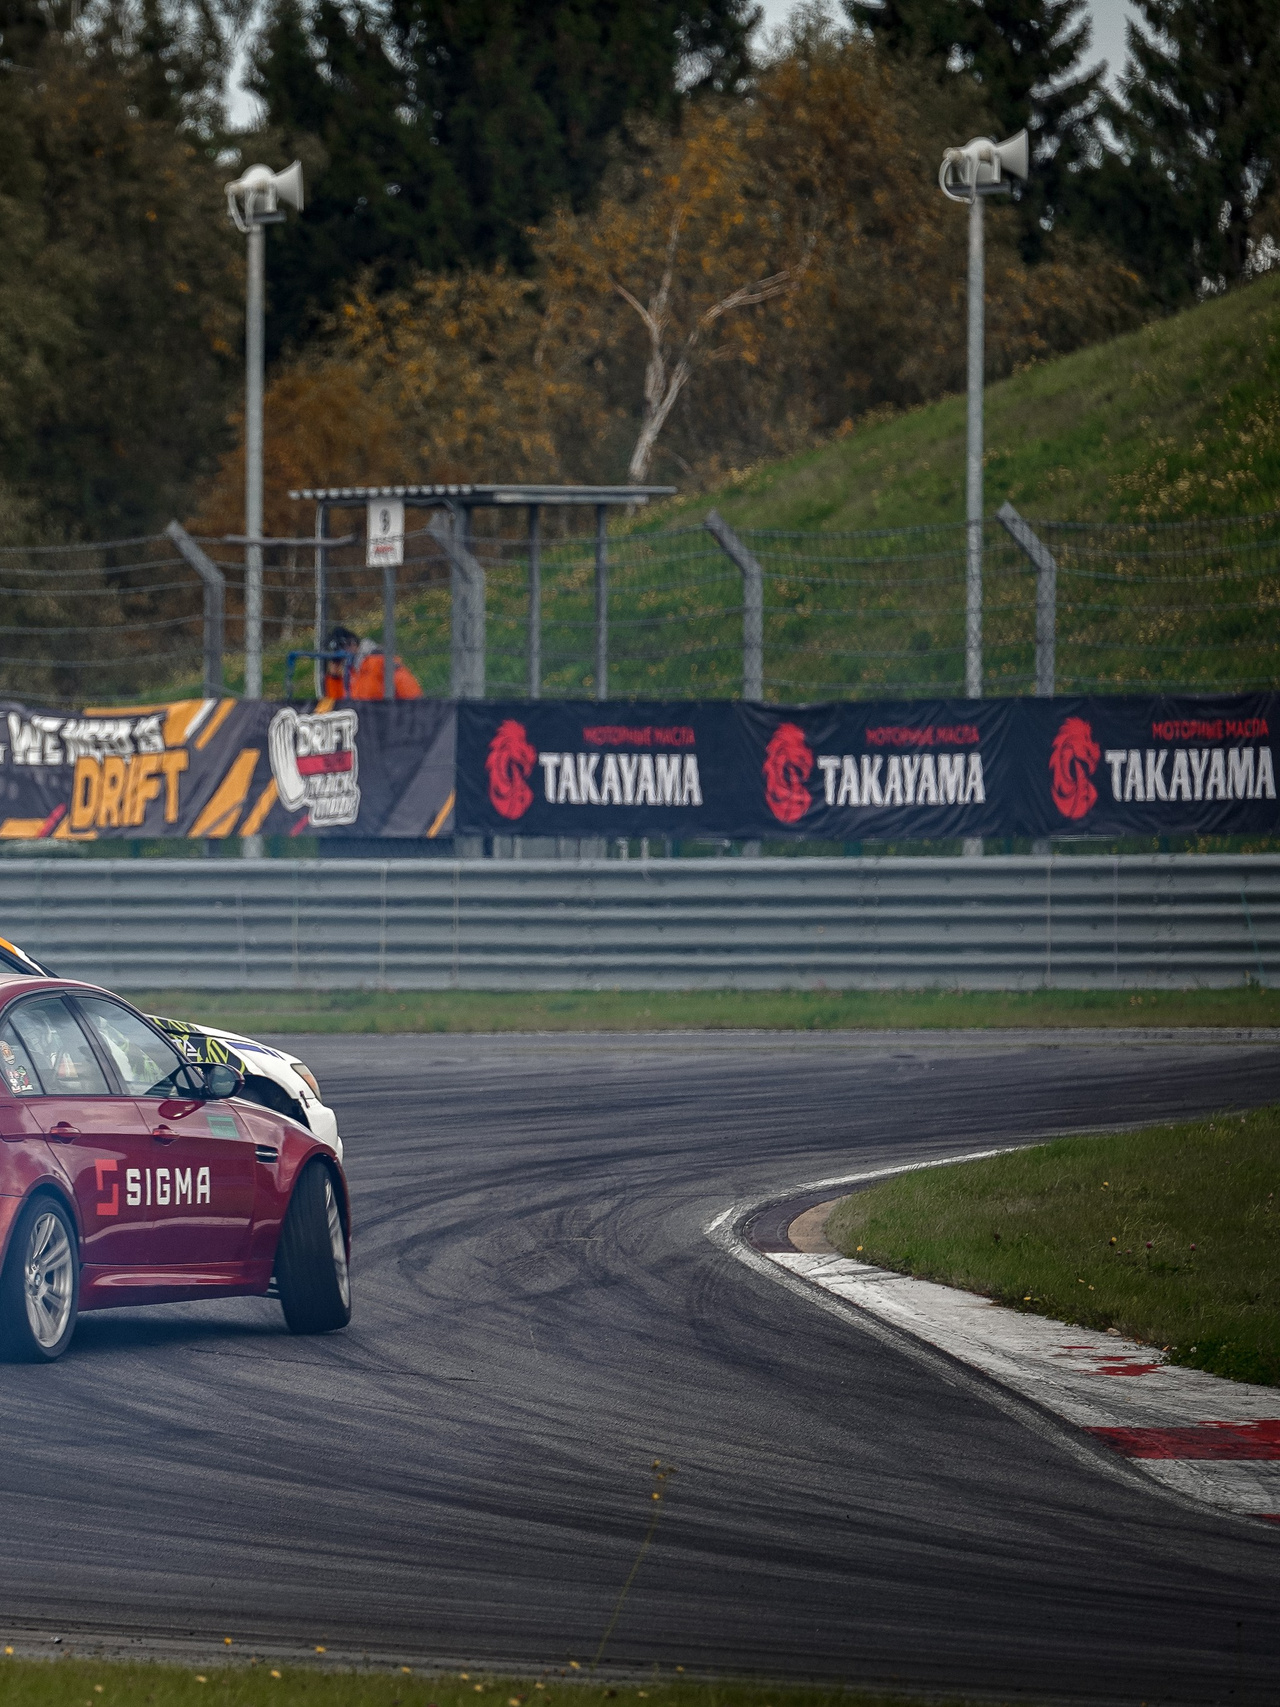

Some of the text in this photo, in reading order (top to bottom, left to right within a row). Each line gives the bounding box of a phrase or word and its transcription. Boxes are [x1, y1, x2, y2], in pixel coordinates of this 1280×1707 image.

[7, 711, 63, 766] WE
[1152, 717, 1269, 740] МОТОРНЫЕ МАСЛА
[70, 749, 189, 830] DRIFT
[538, 752, 703, 807] TAKAYAMA
[817, 752, 986, 807] TAKAYAMA
[1105, 746, 1277, 802] TAKAYAMA
[126, 1166, 211, 1206] SIGMA
